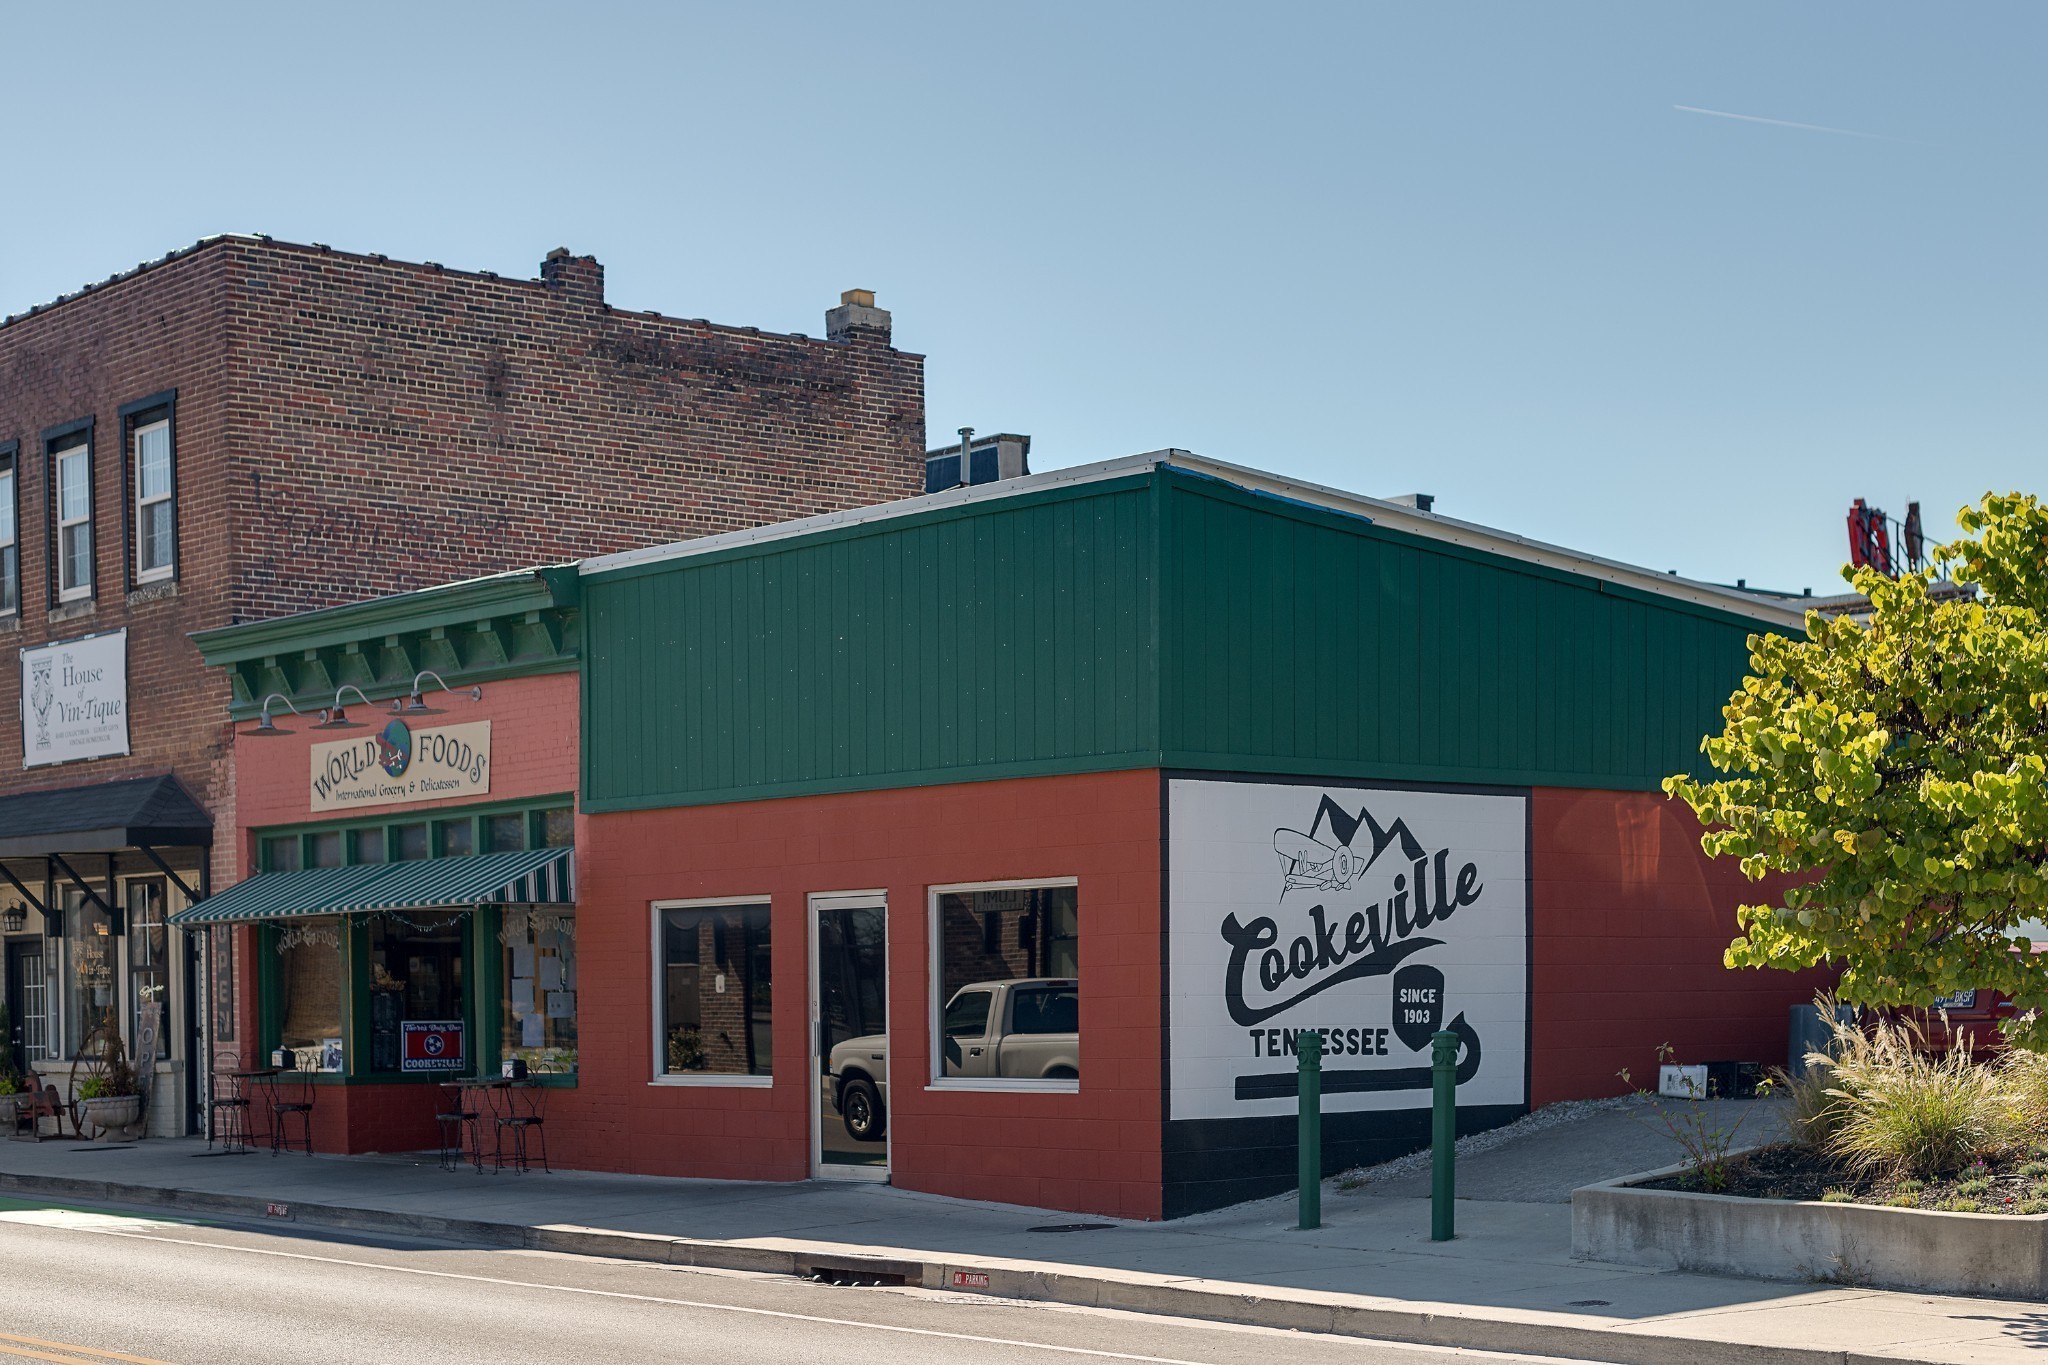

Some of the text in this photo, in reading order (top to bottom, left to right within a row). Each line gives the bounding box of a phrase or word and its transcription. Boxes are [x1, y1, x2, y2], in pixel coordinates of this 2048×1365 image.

[62, 652, 73, 664] The
[63, 665, 103, 687] House
[77, 687, 86, 700] of
[57, 696, 121, 724] Vin-Tique
[313, 734, 486, 801] WORLD FOODS
[335, 777, 460, 801] International Grocery & Delicatessen
[496, 916, 528, 944] WORLD
[1221, 848, 1484, 1026] Cookeville
[275, 930, 302, 955] WORLD
[217, 924, 230, 1034] OPEN
[1400, 988, 1436, 1003] SINCE
[1404, 1009, 1430, 1024] 1903
[1250, 1028, 1389, 1057] TENESSEE
[405, 1059, 462, 1069] COOKEVILLE
